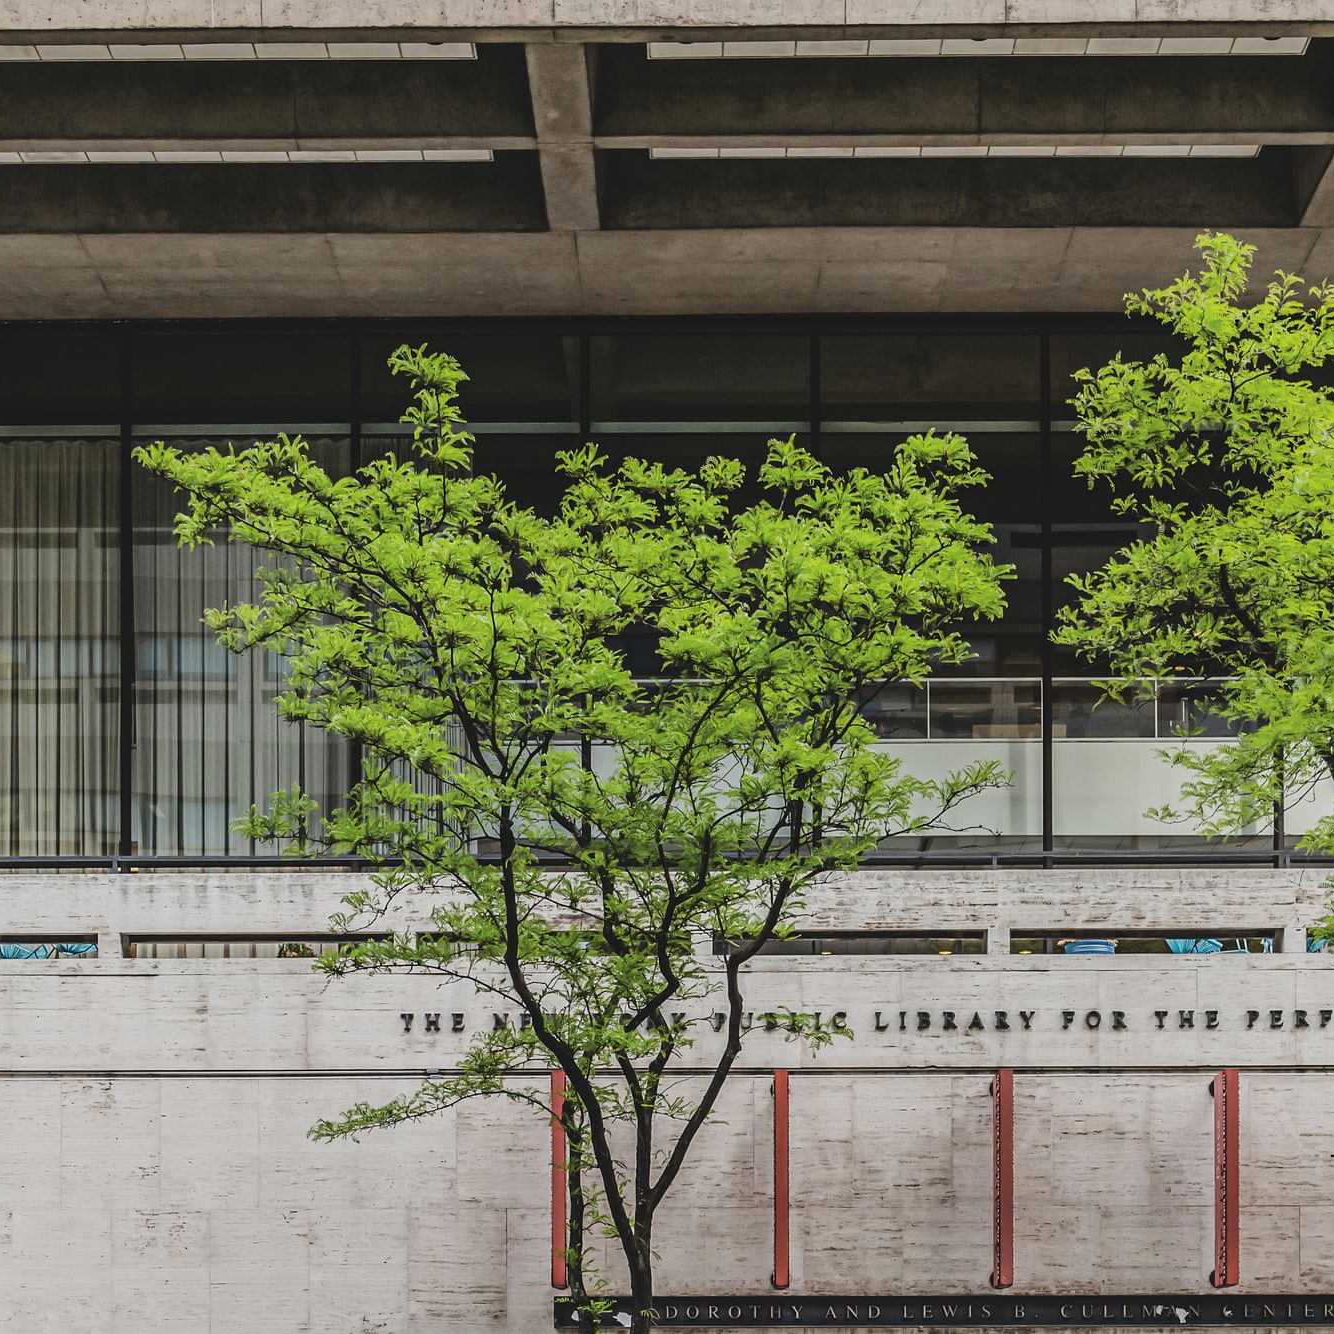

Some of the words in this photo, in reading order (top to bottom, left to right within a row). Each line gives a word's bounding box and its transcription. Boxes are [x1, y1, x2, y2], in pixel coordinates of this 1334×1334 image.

[400, 1012, 466, 1033] THE
[873, 1010, 1036, 1032] LIBRARY
[1062, 1010, 1128, 1030] FOR
[1154, 1010, 1220, 1030] THE
[665, 1305, 805, 1320] DOROTHY
[824, 1305, 882, 1320] AND
[903, 1305, 992, 1320] LEWIS
[1014, 1304, 1039, 1319] B.
[1060, 1304, 1201, 1319] CULLMAN
